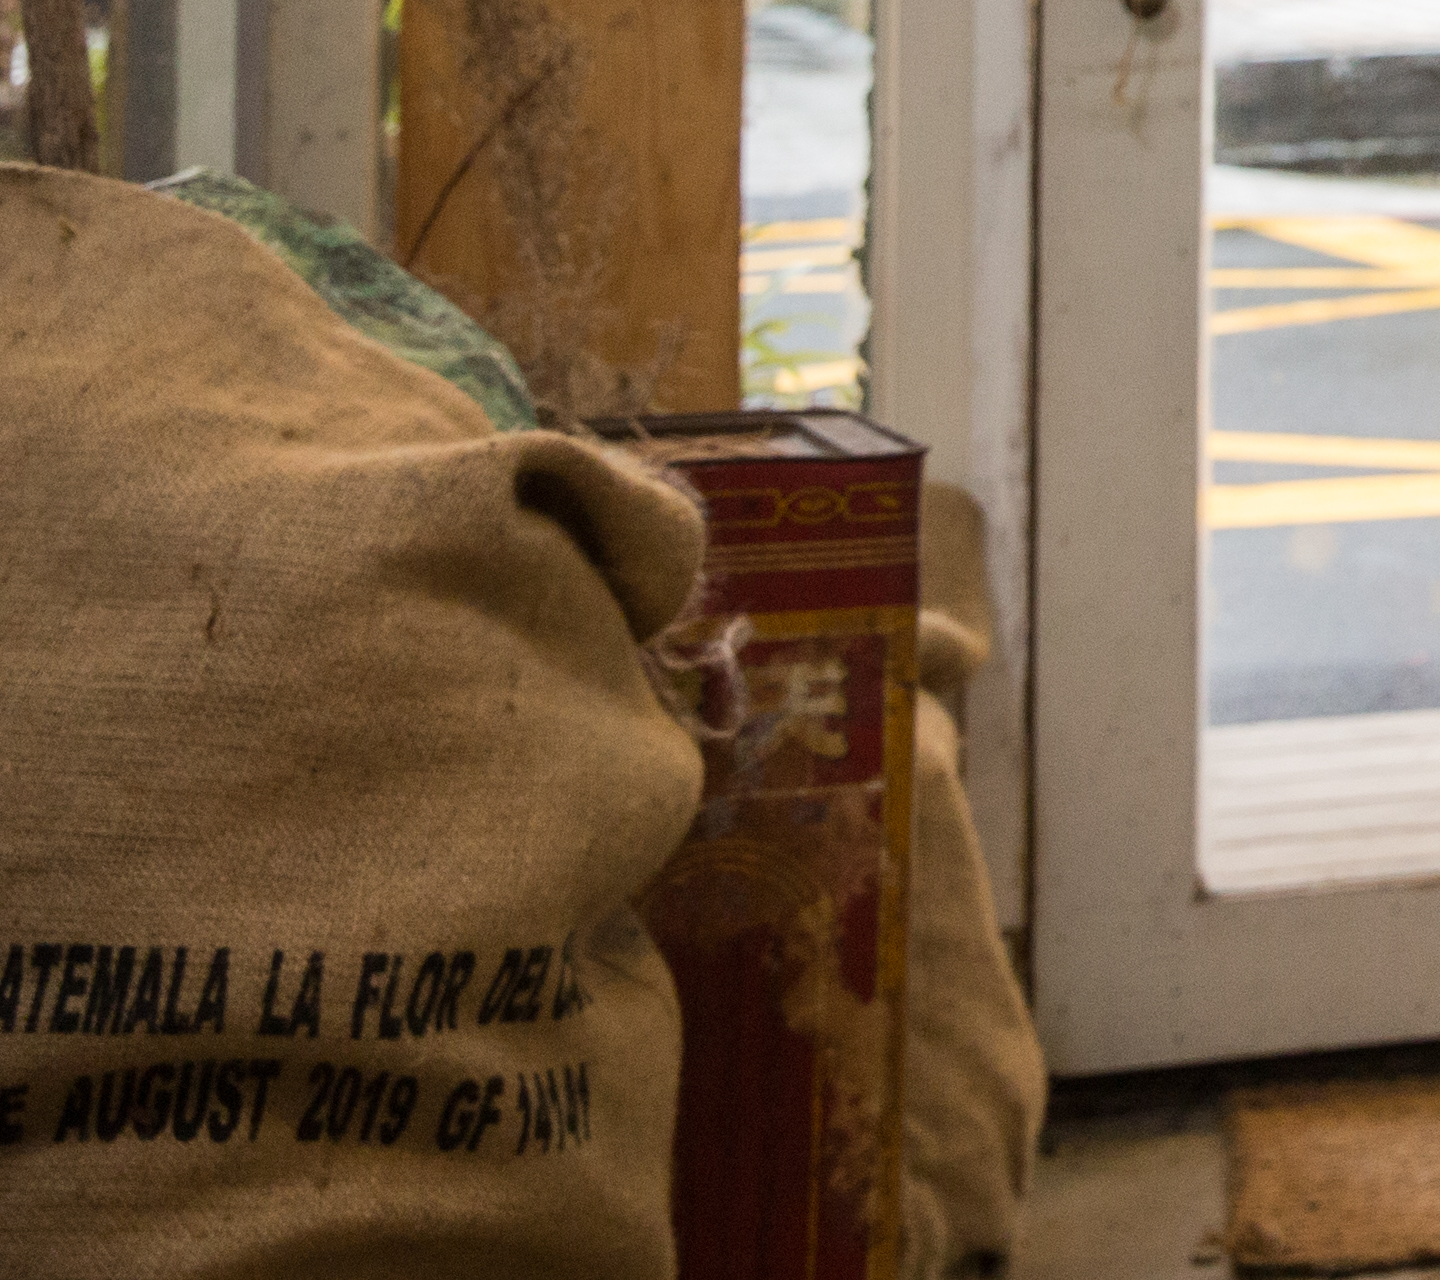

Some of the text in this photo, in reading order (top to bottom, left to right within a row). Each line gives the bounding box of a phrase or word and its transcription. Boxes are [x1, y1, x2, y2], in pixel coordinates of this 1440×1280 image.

[258, 950, 325, 1039] LA
[351, 950, 476, 1040] FLOR
[53, 1058, 281, 1142] AUGUST
[295, 1060, 418, 1146] 2019
[435, 1074, 505, 1153] GF
